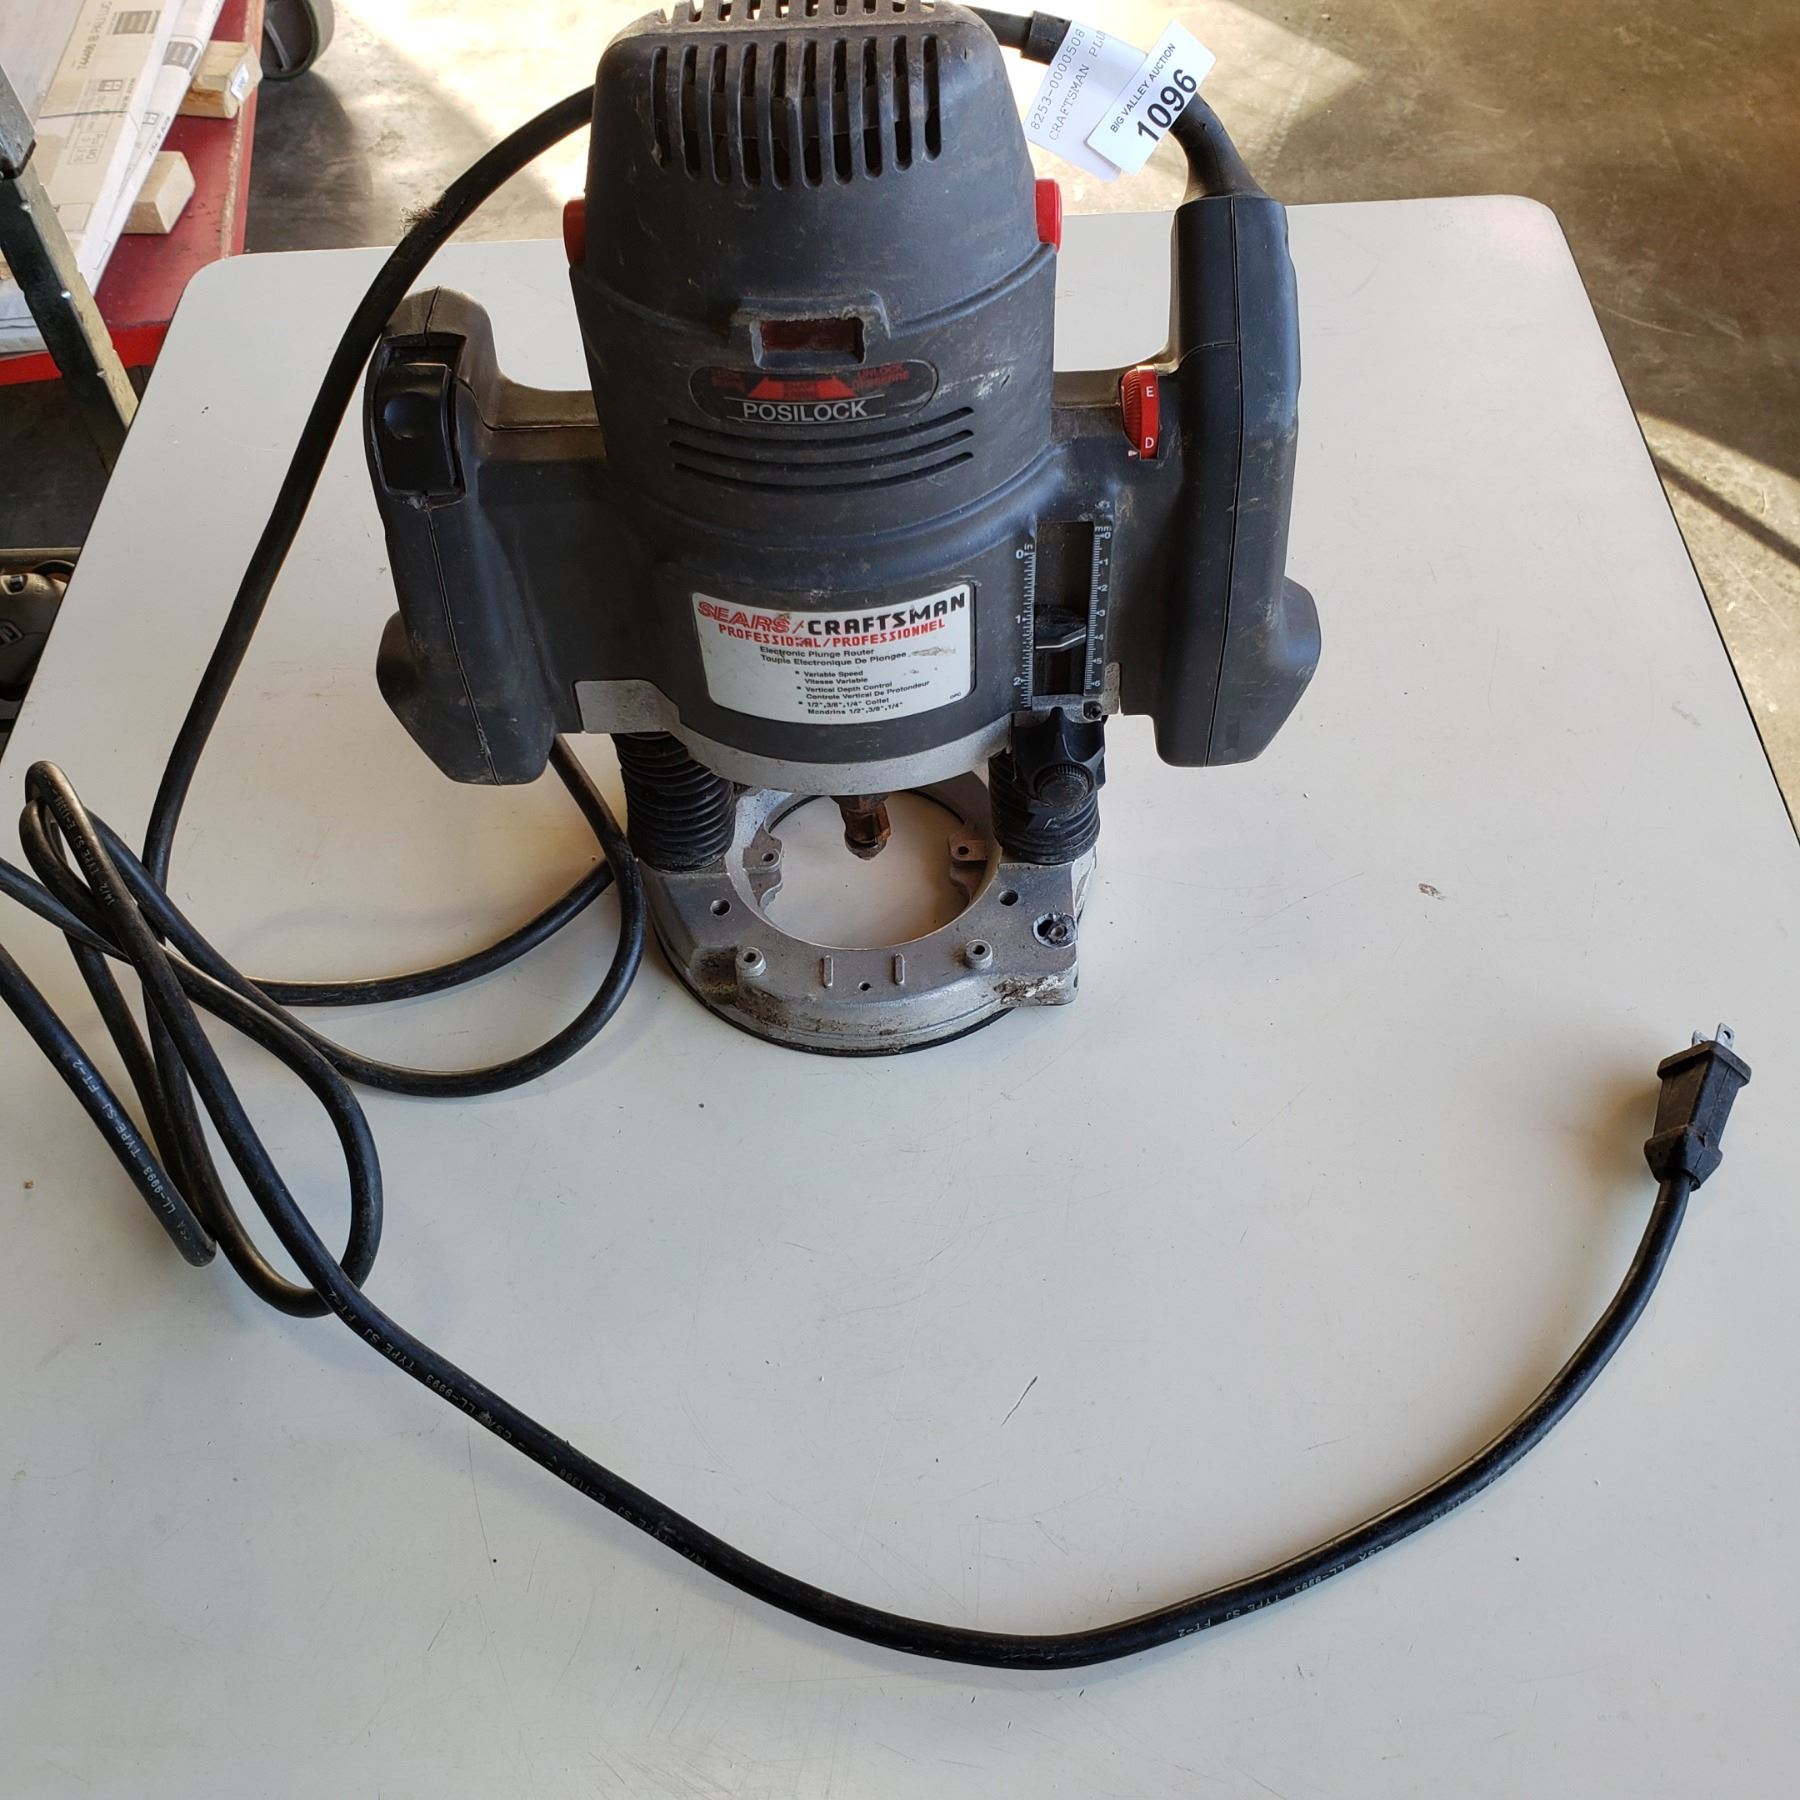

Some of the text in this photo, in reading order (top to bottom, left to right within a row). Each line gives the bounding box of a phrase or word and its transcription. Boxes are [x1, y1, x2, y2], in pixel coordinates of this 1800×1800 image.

[1030, 28, 1085, 130] 8253-0000508
[1110, 43, 1176, 133] BIG VALLEY AUCTION
[1049, 63, 1090, 141] CRAFTSMAN
[1137, 68, 1197, 142] 1096
[1145, 385, 1155, 398] E
[743, 401, 868, 421] POSILOCK
[1144, 436, 1155, 449] D
[1094, 524, 1112, 532] mm
[1023, 542, 1034, 550] in
[1015, 550, 1025, 559] 0
[1103, 558, 1109, 566] 1
[1101, 584, 1108, 592] 2
[1015, 615, 1022, 624] 1
[760, 646, 875, 659] Electronic Plunge Router
[794, 658, 852, 667] Electronique
[836, 676, 868, 684] Variable
[838, 670, 863, 679] Speed
[1013, 676, 1022, 685] 2
[836, 685, 861, 694] Depth
[862, 681, 893, 691] Control
[842, 691, 872, 699] Vertical
[874, 689, 885, 697] De
[887, 680, 930, 695] Profondeur
[72, 1059, 100, 1093] FT-2
[102, 1102, 119, 1120] SJ
[115, 1124, 141, 1158] TYPE
[143, 1165, 176, 1215] LL-9993
[363, 1327, 381, 1344] SJ
[384, 1342, 416, 1372] TYPE
[425, 1374, 476, 1414] LL-9993
[1247, 1594, 1281, 1612] TYPE
[1226, 1608, 1241, 1619] SJ
[1177, 1618, 1212, 1638] FT-2
